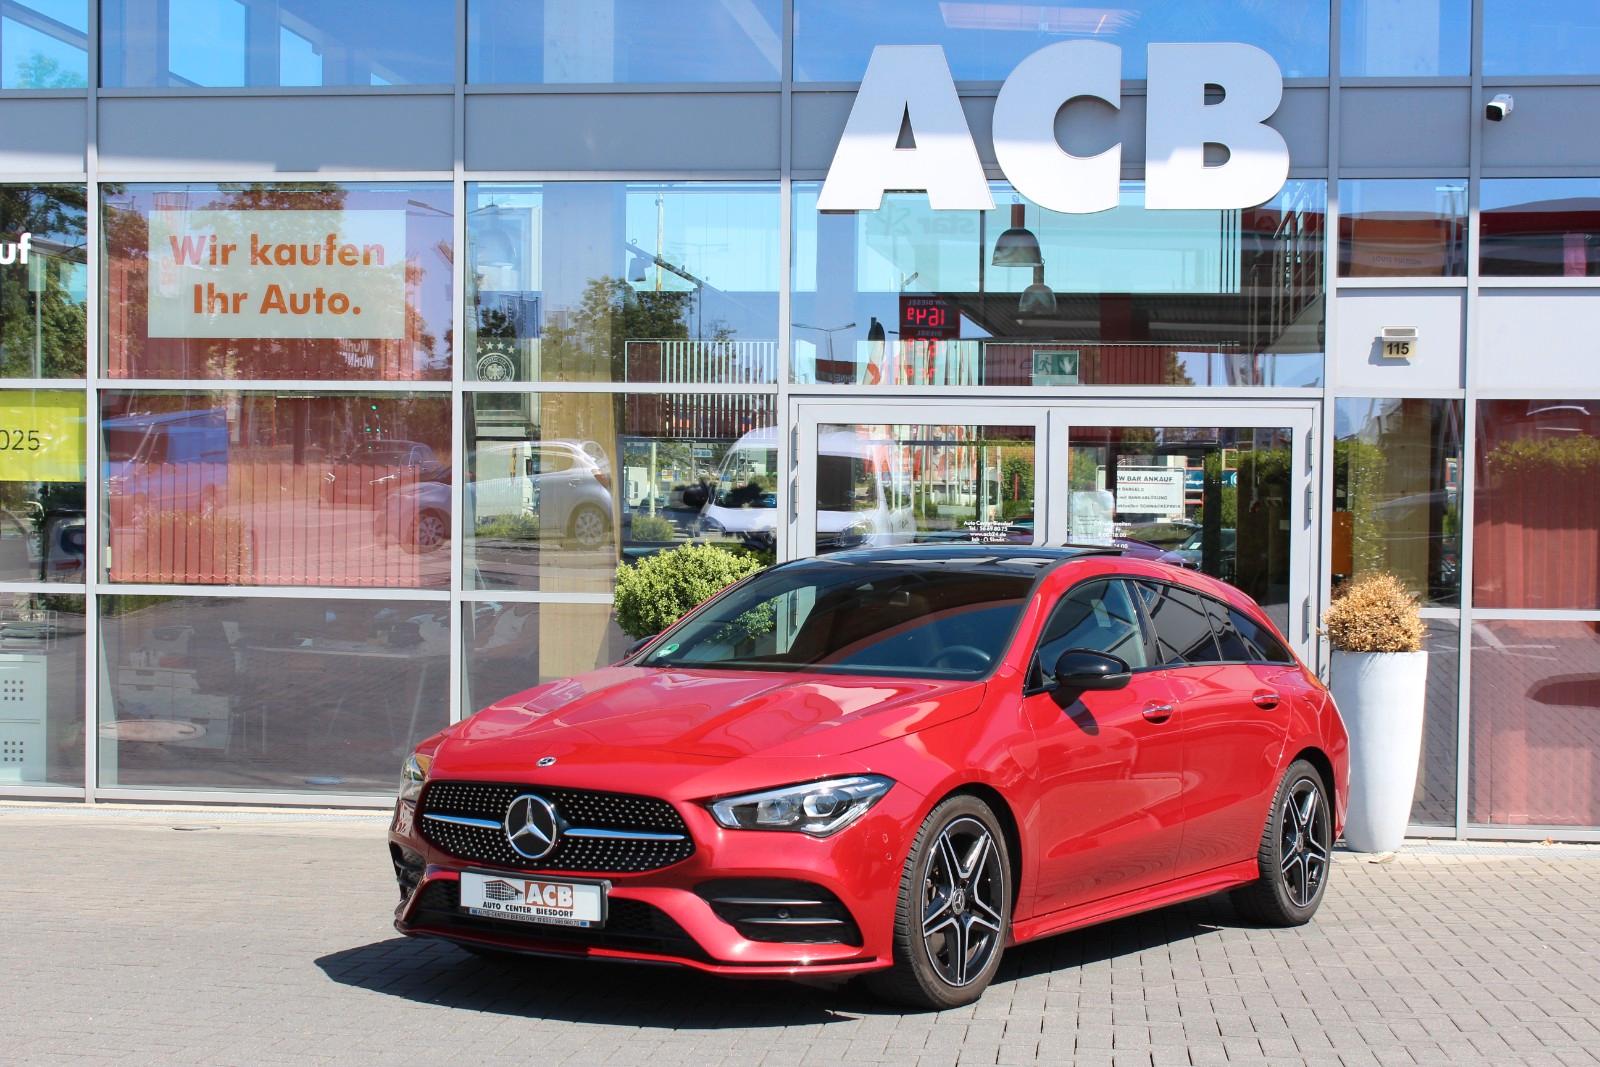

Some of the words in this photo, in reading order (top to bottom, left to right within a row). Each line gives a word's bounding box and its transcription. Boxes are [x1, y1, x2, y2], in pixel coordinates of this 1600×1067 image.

[816, 40, 1290, 213] ACB
[169, 234, 236, 266] Wir
[250, 233, 385, 266] kaufen
[193, 283, 248, 314] Ihr
[259, 284, 361, 315] Auto.
[1386, 342, 1410, 355] 115
[482, 901, 501, 910] AUTO
[505, 904, 532, 914] CENTER
[536, 907, 574, 918] BIESDORF
[526, 883, 573, 908] ACB
